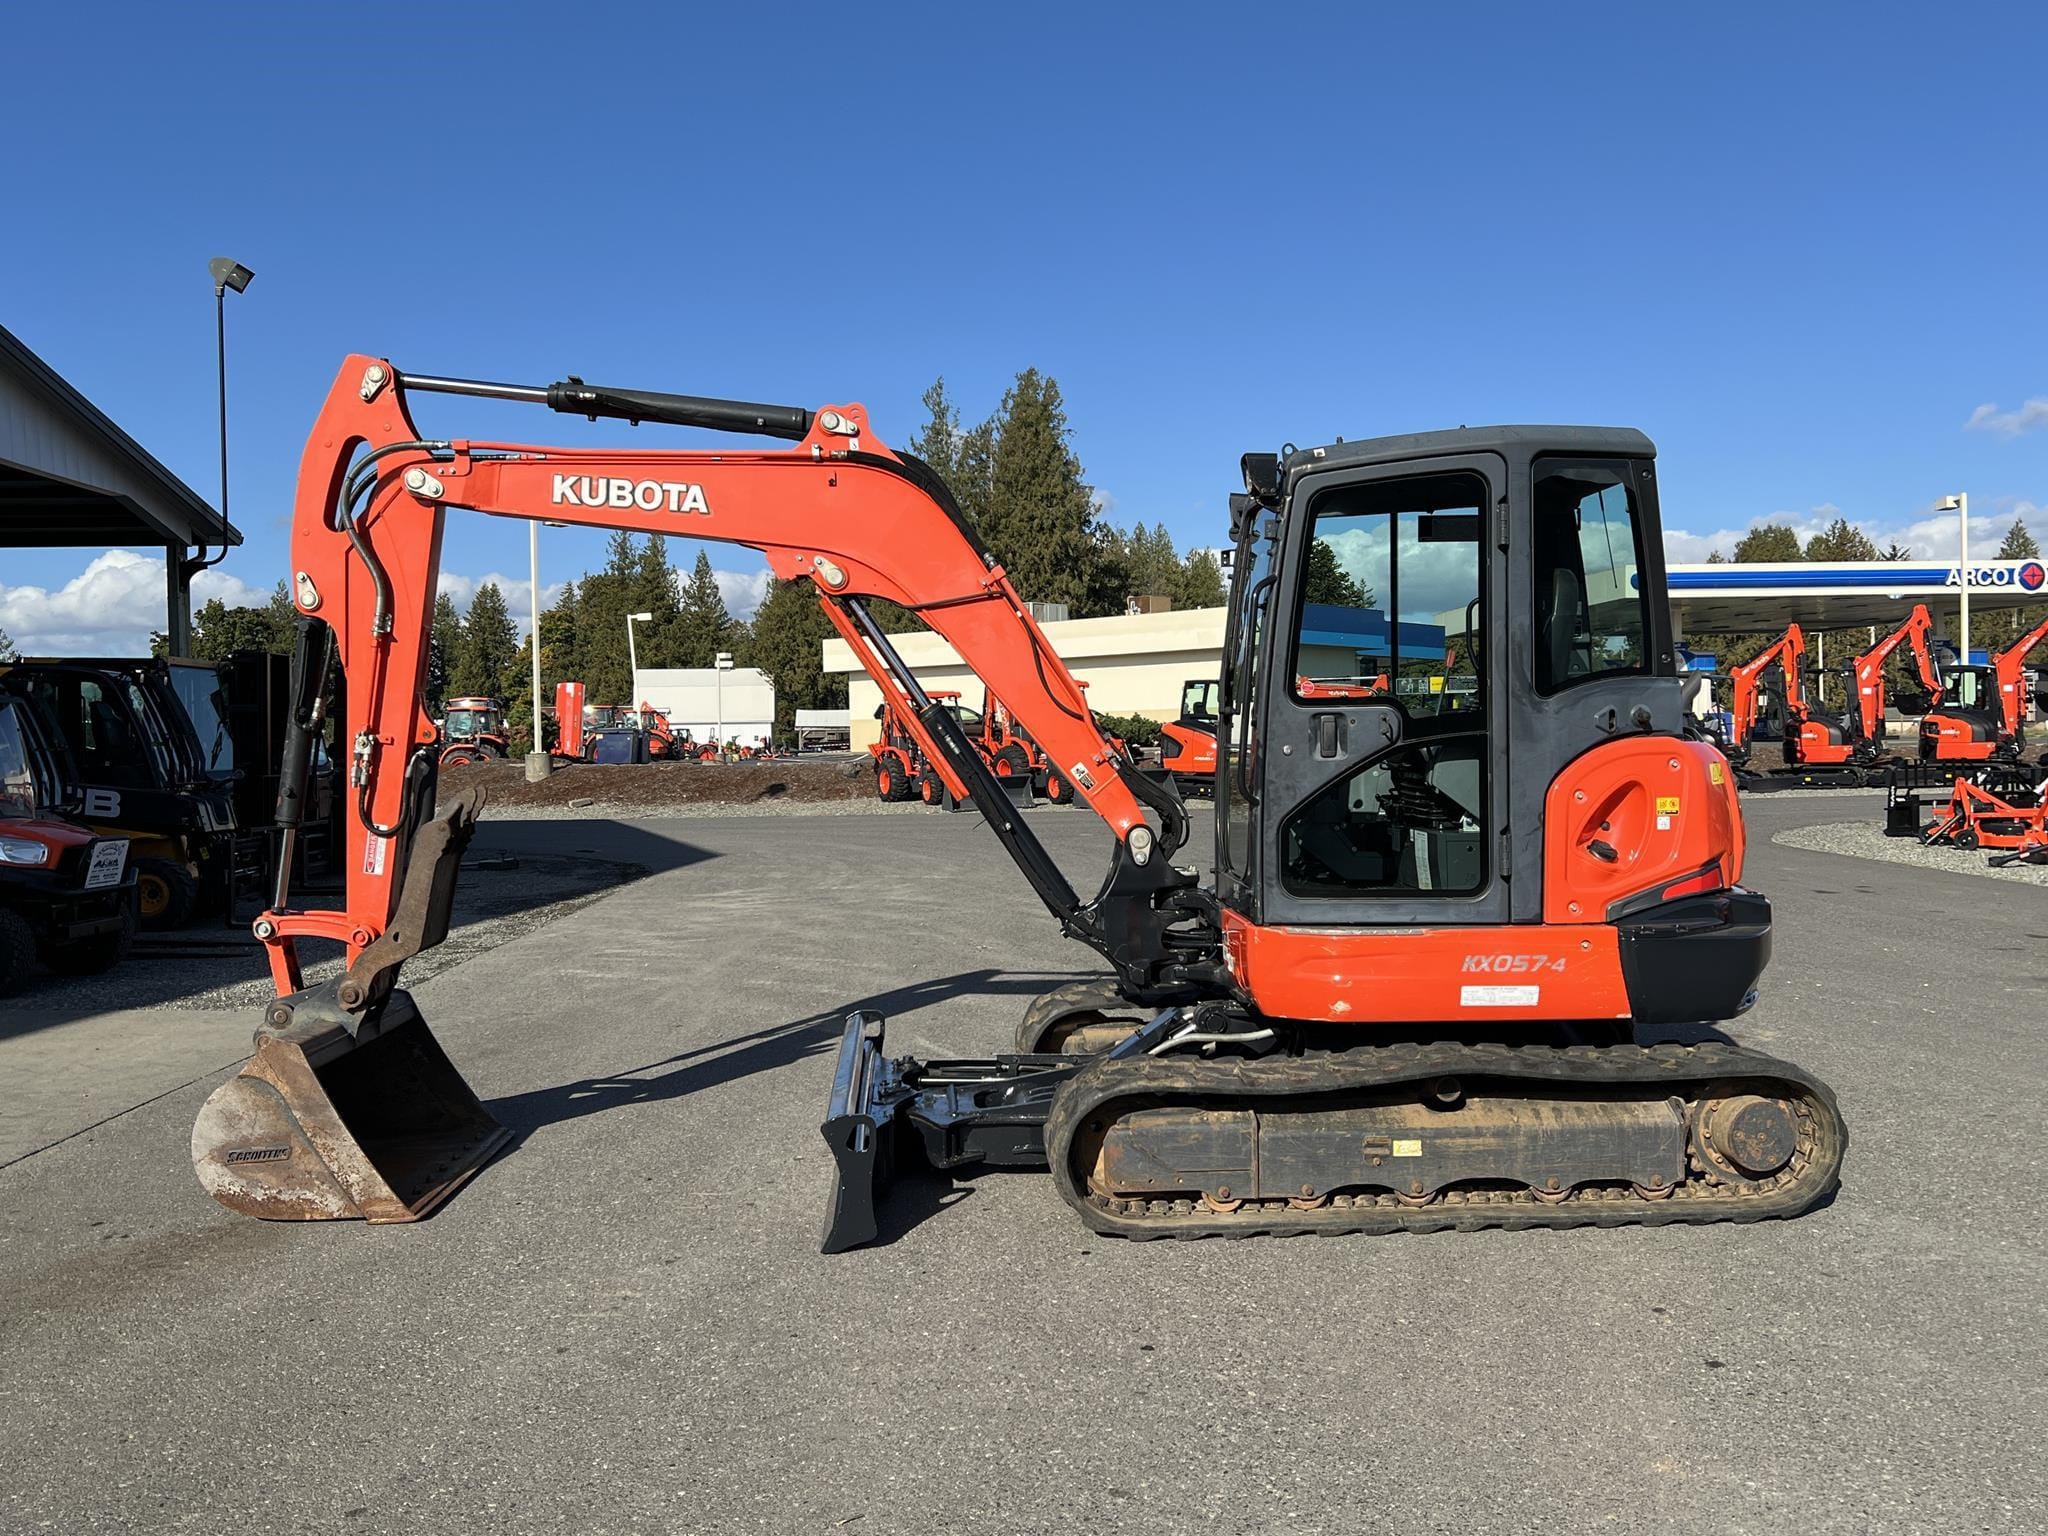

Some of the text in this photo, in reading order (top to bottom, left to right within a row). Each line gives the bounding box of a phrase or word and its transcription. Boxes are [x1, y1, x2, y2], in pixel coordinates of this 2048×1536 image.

[552, 473, 710, 514] KUBOTA
[1945, 568, 2010, 586] ARCO
[1461, 954, 1567, 972] KX057-4
